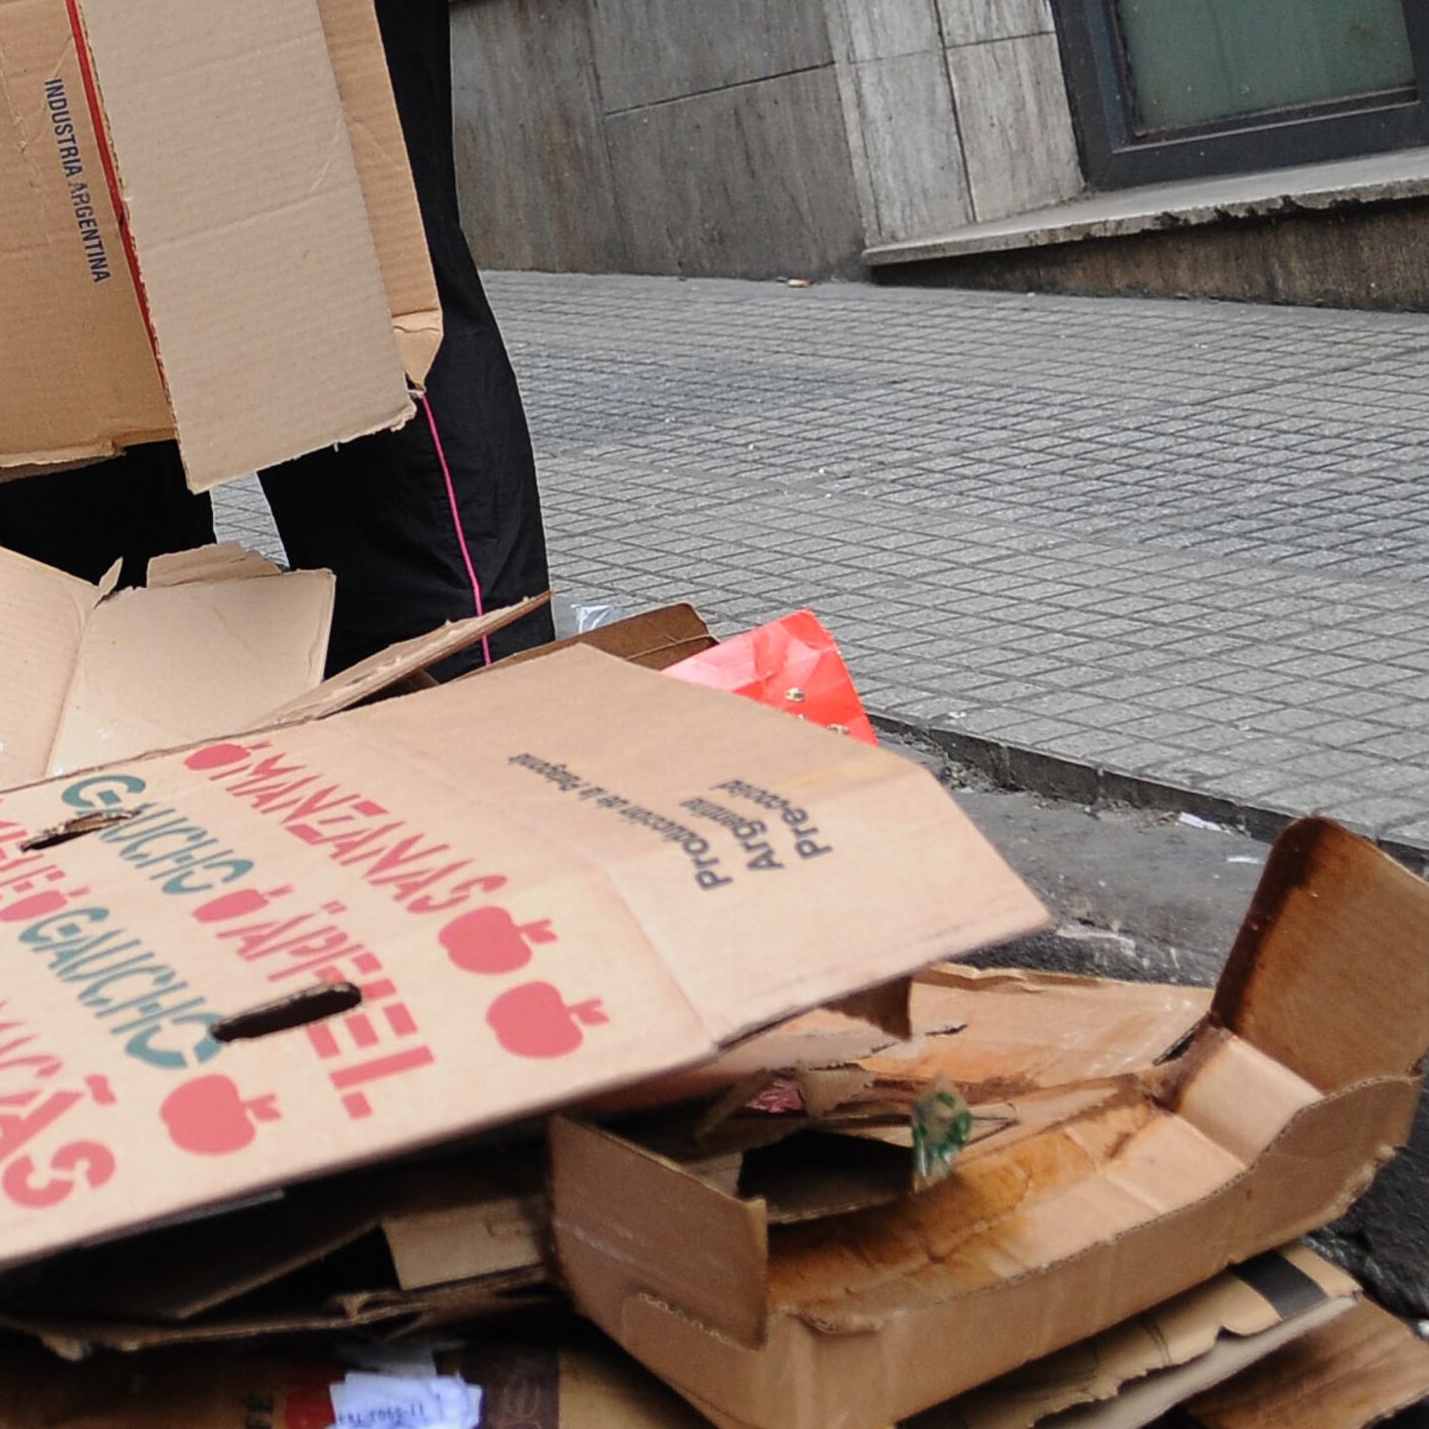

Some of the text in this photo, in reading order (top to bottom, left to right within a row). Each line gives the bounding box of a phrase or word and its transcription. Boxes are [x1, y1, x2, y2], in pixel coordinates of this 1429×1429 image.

[44, 78, 112, 284] INDUSTRIA ARGENTINA
[209, 751, 508, 915] MANZANAS
[18, 906, 226, 1071] GAUCHO
